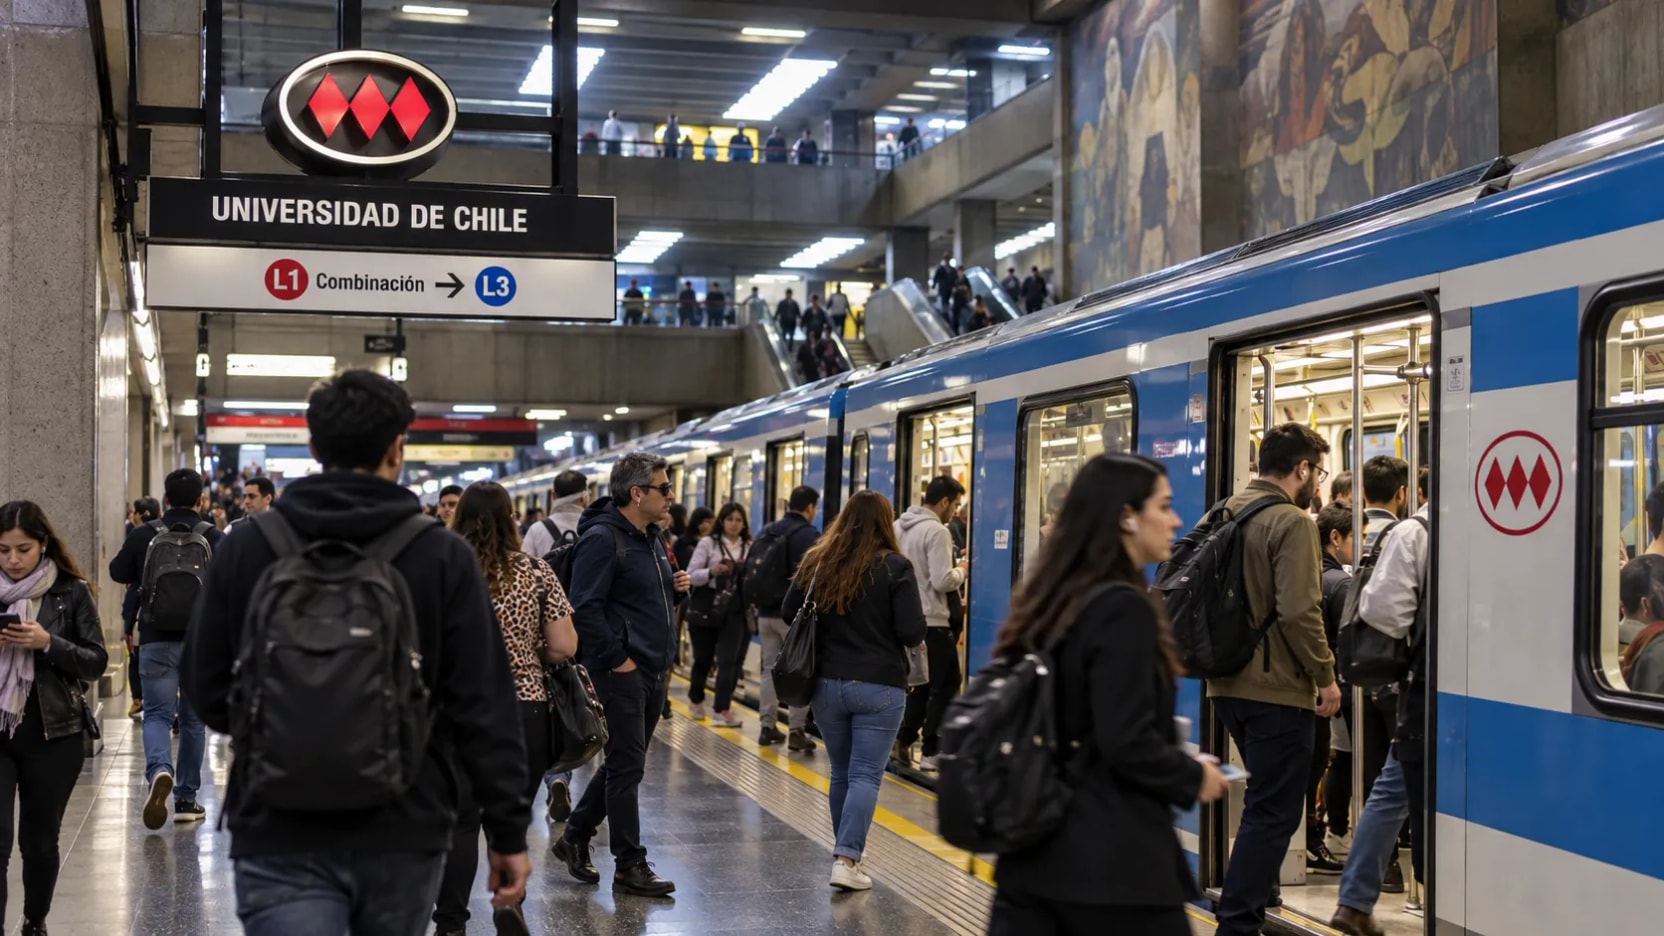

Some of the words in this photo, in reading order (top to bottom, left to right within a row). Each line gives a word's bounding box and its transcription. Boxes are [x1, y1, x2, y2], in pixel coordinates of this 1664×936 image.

[212, 195, 400, 227] UNIVERSIDAD
[410, 204, 445, 230] DE
[454, 205, 528, 233] CHILE
[272, 267, 299, 291] L1
[316, 272, 425, 294] Combinación
[482, 275, 509, 297] L3
